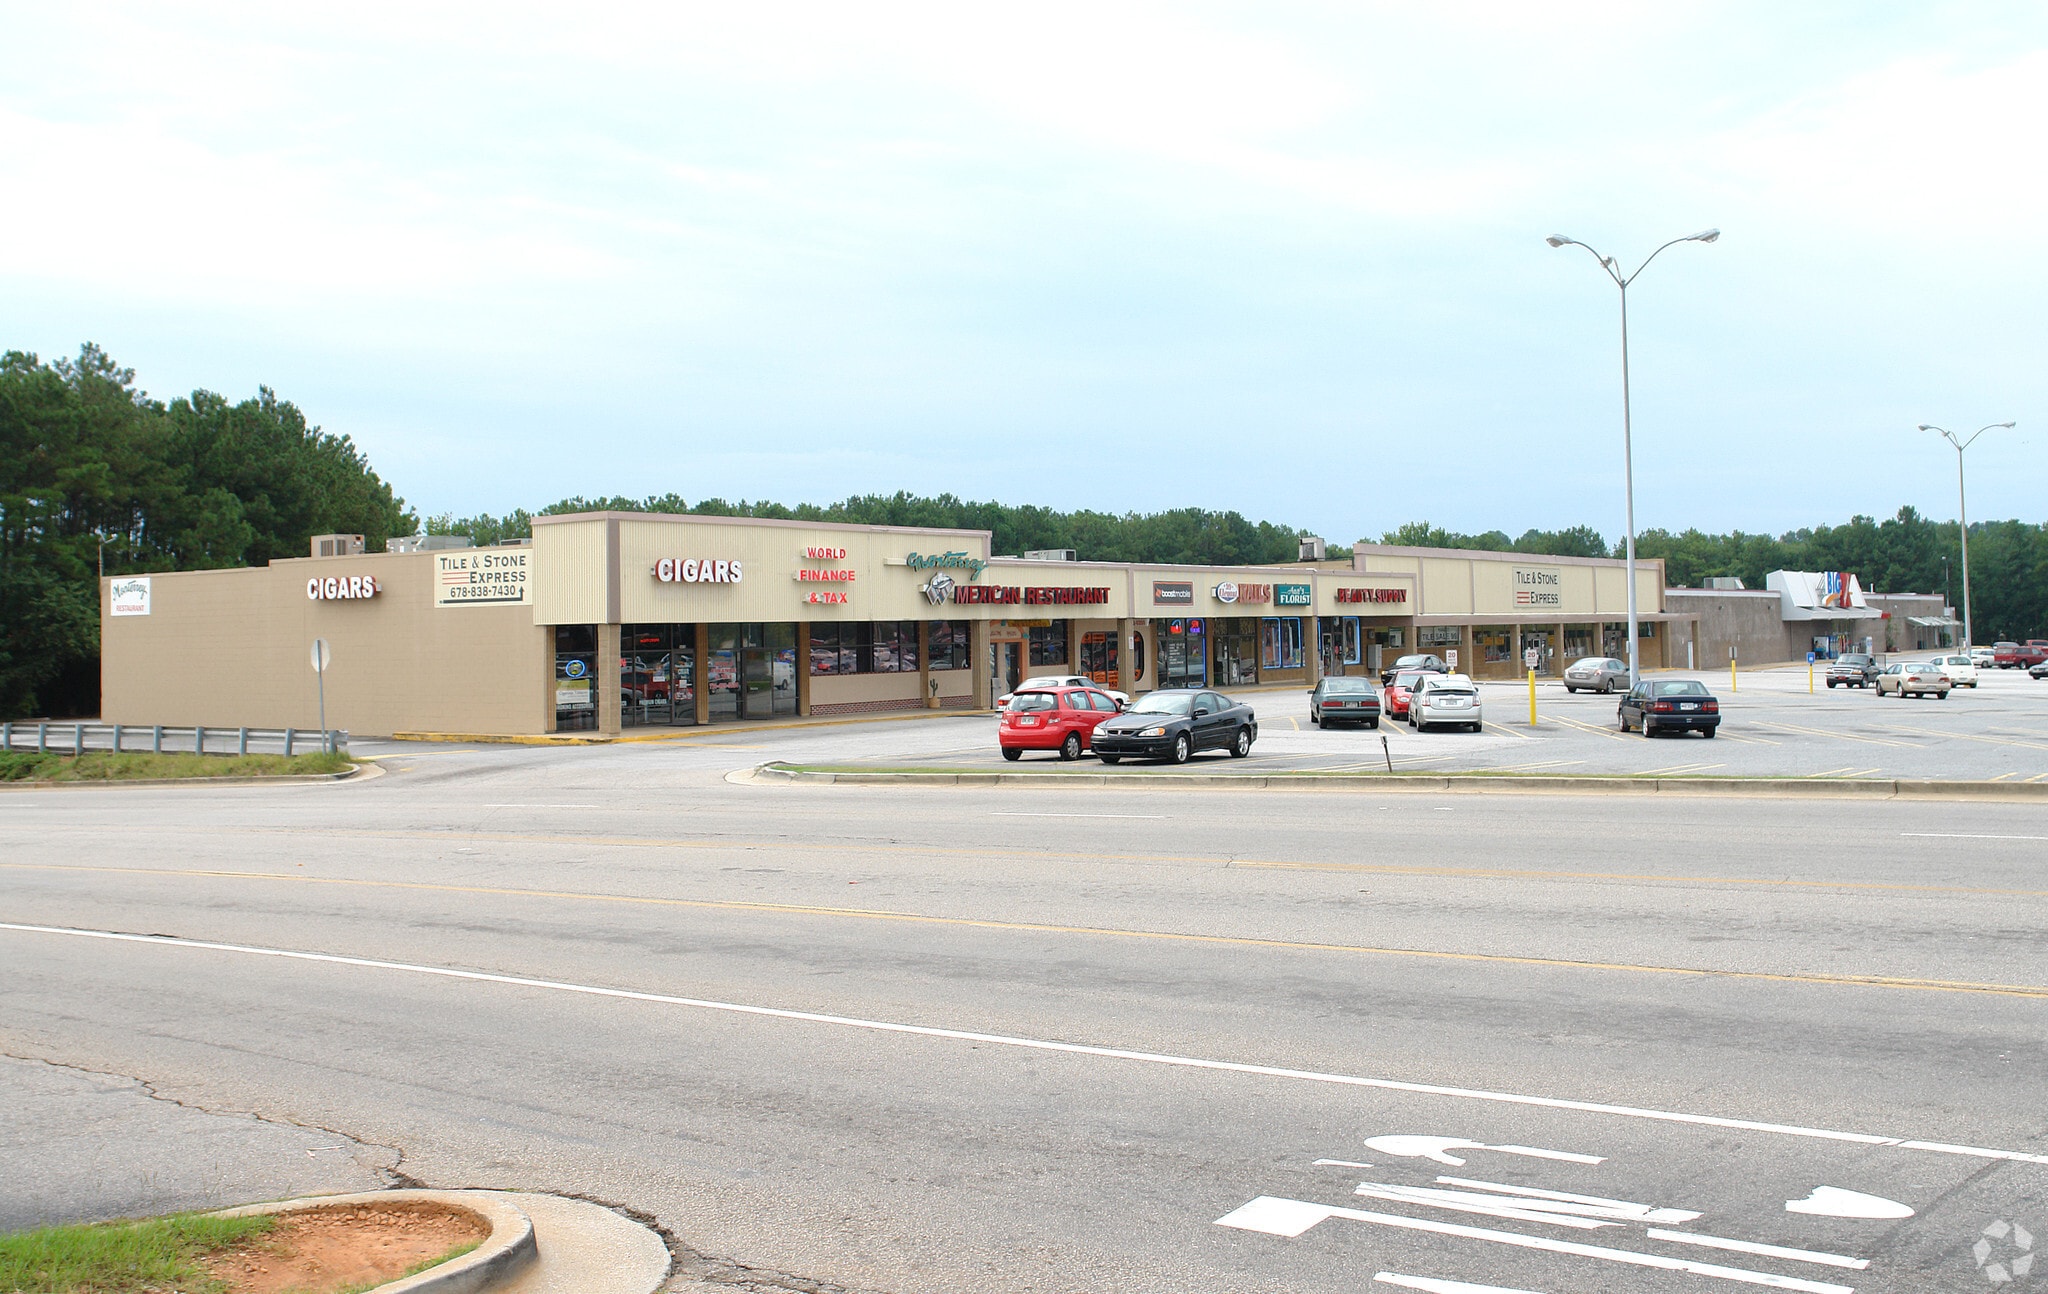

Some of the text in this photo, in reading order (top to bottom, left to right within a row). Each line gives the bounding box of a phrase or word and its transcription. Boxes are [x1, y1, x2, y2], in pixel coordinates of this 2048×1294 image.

[807, 547, 846, 559] WORLD
[439, 554, 526, 570] TILE & STONE
[656, 558, 743, 583] CIGARS
[799, 570, 855, 581] FINANCE
[470, 571, 526, 584] EXPRESS
[1516, 571, 1531, 584] TILE
[1537, 571, 1558, 585] STONE
[307, 575, 375, 600] CIGARS
[809, 592, 848, 603] & TAX
[954, 586, 1111, 605] MEXICAN RESTAURANT
[1280, 595, 1310, 604] FLORIST
[1338, 588, 1407, 603] BEAUTY SUPPLY
[1530, 591, 1559, 604] EXPRESS
